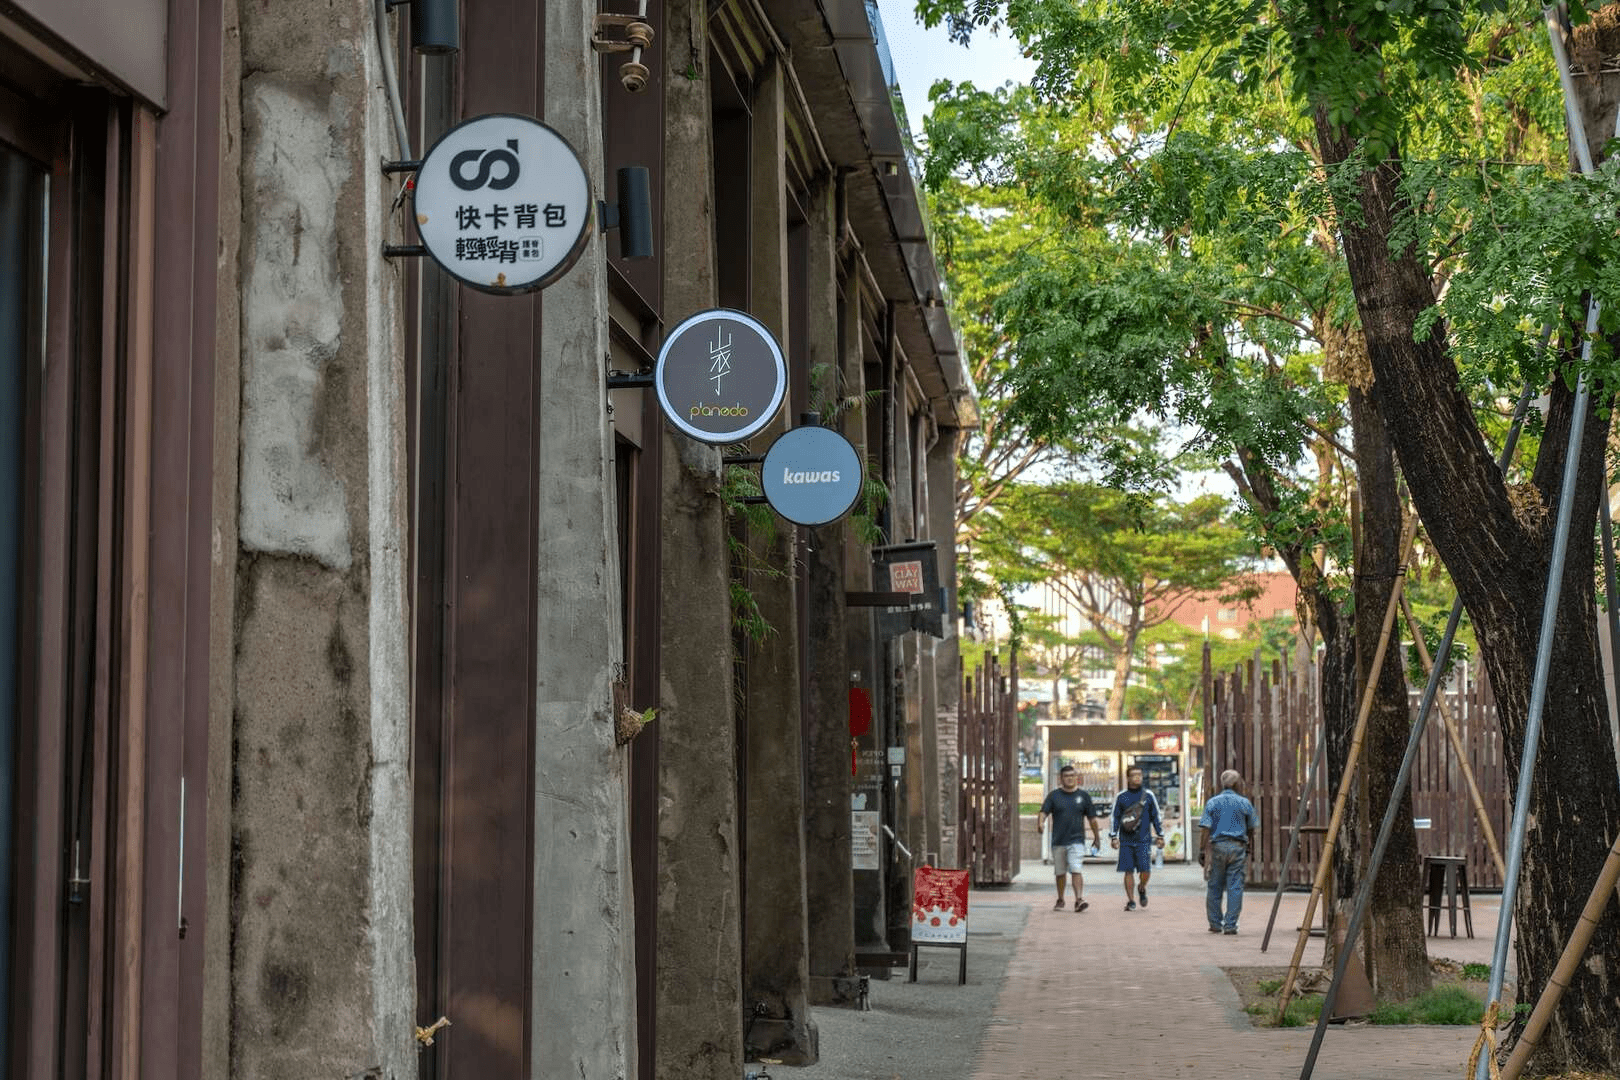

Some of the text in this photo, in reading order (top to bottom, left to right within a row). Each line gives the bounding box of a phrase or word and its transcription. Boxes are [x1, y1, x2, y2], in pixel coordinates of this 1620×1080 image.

[455, 203, 567, 230] 快卡背包
[456, 236, 519, 263] 輕輕背
[783, 467, 840, 484] kawas
[894, 568, 918, 579] CLAY
[895, 579, 918, 589] WAY
